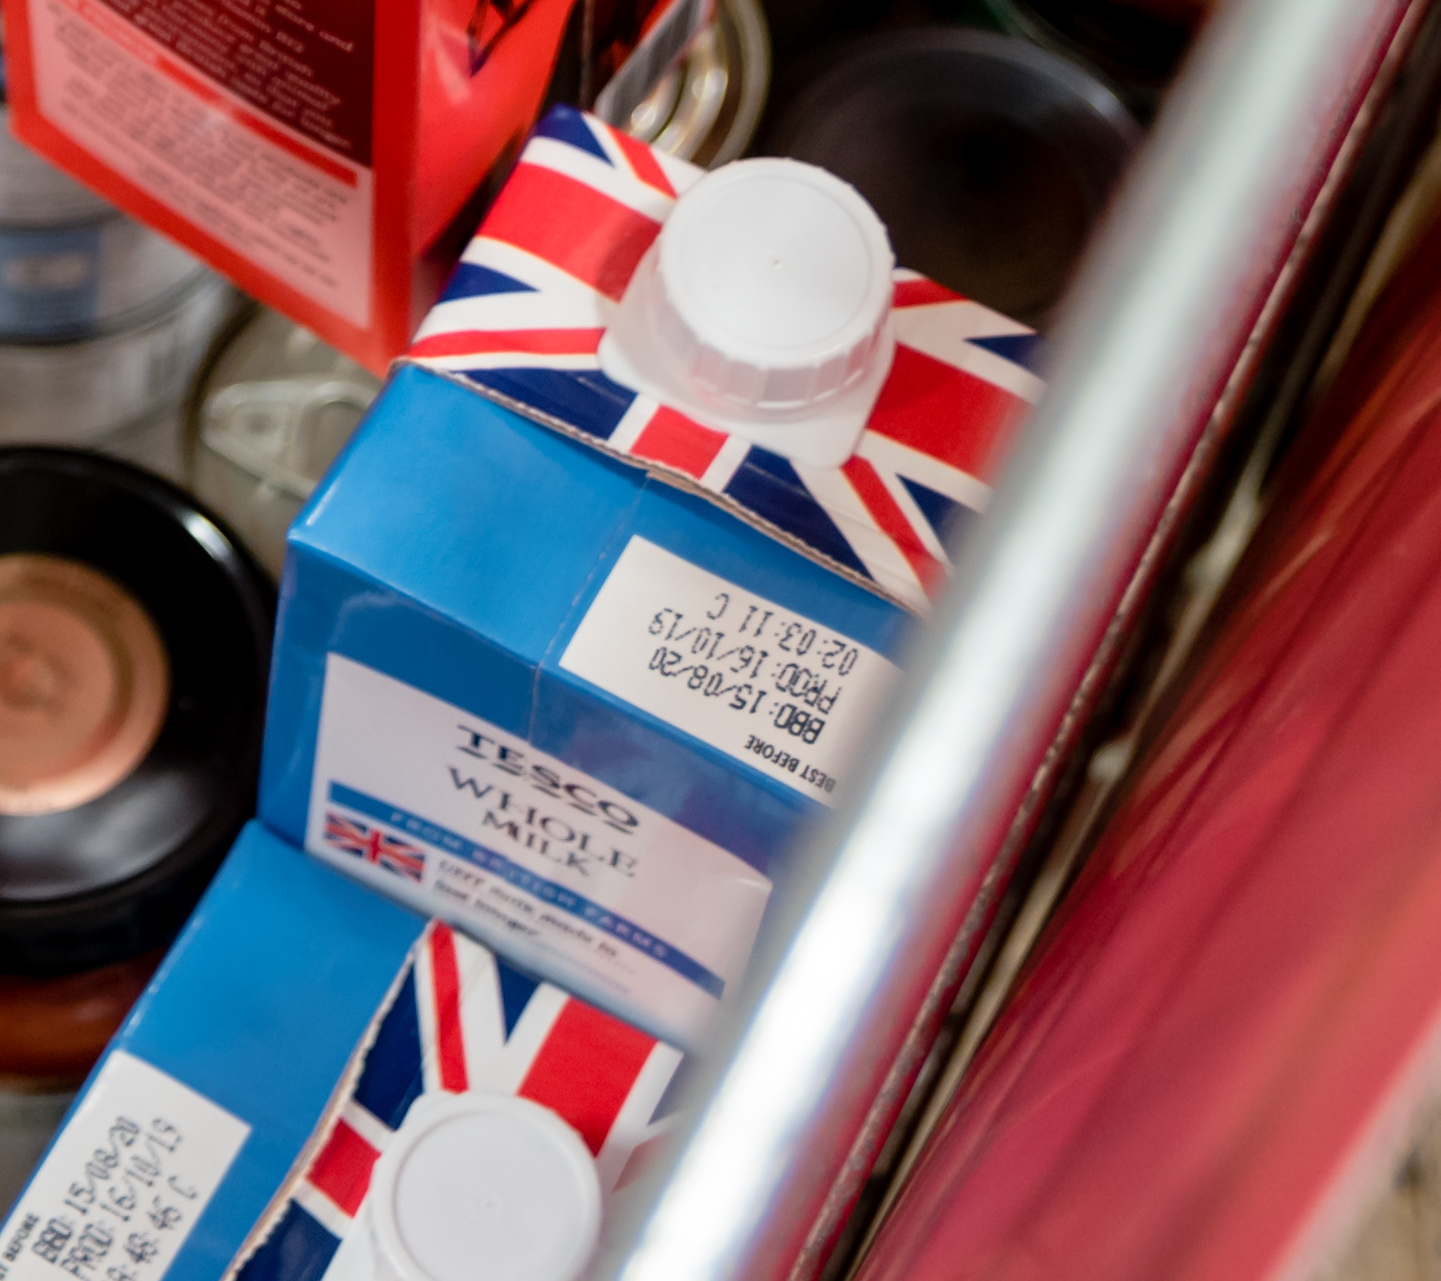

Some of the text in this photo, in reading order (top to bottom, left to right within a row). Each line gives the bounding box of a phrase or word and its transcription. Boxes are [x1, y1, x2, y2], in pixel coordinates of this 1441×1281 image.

[457, 725, 640, 829] TESCO
[744, 734, 836, 793] BEST BEFORE
[447, 764, 639, 879] WHOLE
[482, 810, 590, 878] MILK
[390, 811, 669, 959] FROM BRITISH FARMS
